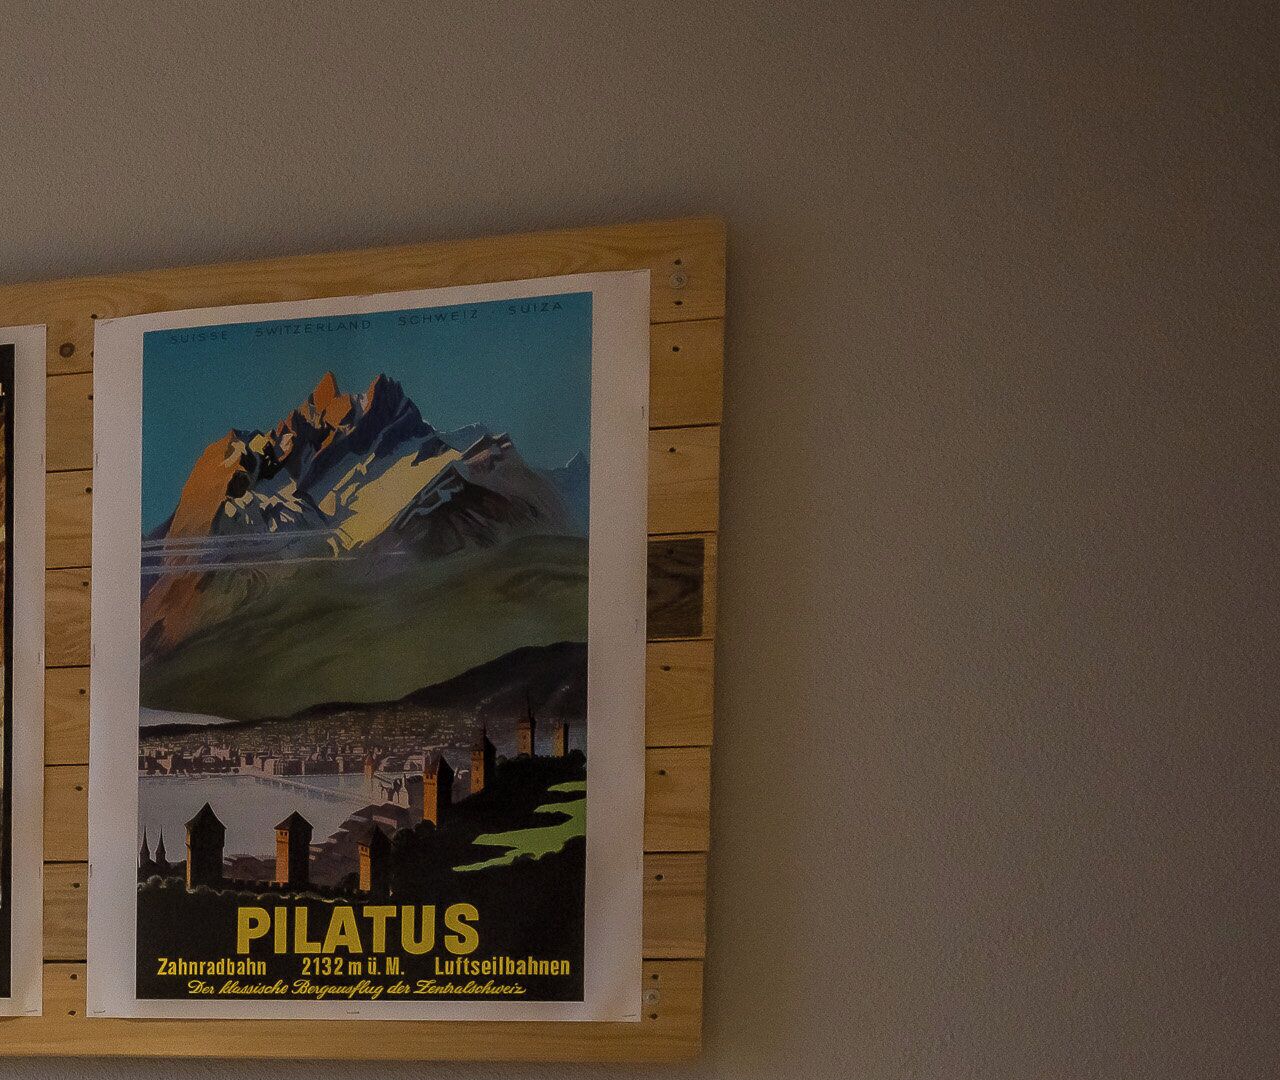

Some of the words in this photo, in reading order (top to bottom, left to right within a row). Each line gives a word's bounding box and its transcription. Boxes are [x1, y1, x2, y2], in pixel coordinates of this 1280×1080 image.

[170, 330, 228, 344] SUISSE
[255, 320, 371, 338] SWITZERLAND
[398, 309, 478, 326] SCHWEIZ
[508, 301, 564, 315] SUIZA
[237, 903, 479, 955] PILATUS
[157, 957, 267, 976] Zahnradbahn
[301, 957, 344, 976] 2132
[348, 960, 362, 976] m
[367, 957, 381, 976] ü.
[385, 957, 405, 976] M.
[435, 956, 570, 976] Luftseilbahnen
[188, 979, 215, 994] Der
[218, 979, 288, 995] klassische
[291, 979, 384, 1000] Bergausflug
[386, 979, 411, 995] der
[413, 979, 527, 995] Zentralschweiz
